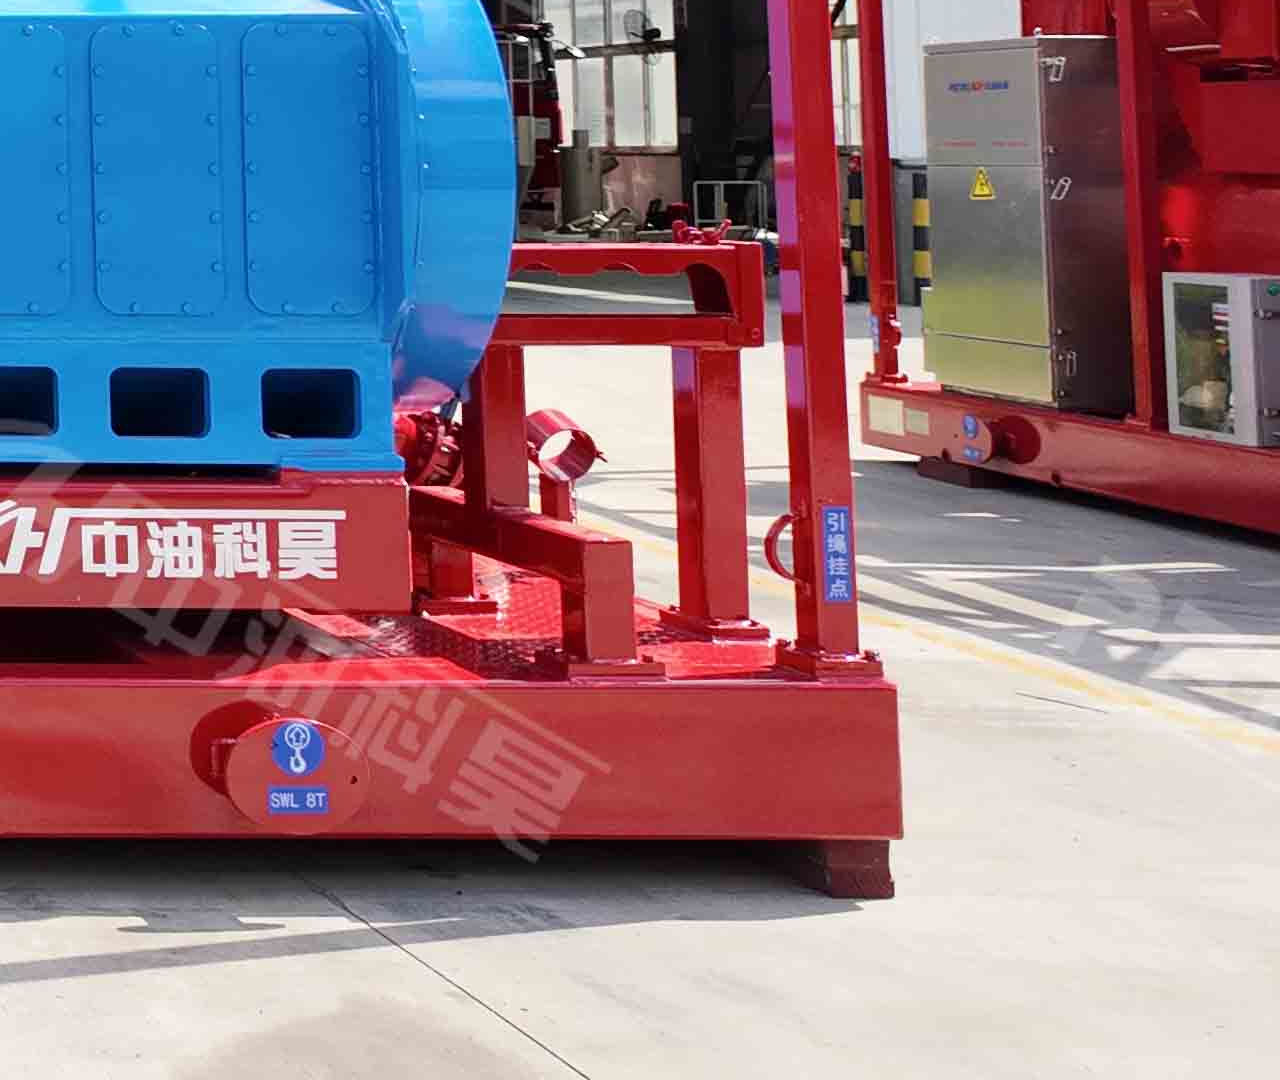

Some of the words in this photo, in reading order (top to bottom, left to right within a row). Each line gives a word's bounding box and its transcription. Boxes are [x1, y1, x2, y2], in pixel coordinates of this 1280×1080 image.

[82, 520, 337, 581] 中油科昊
[271, 792, 299, 808] SWL
[306, 792, 327, 808] 8T
